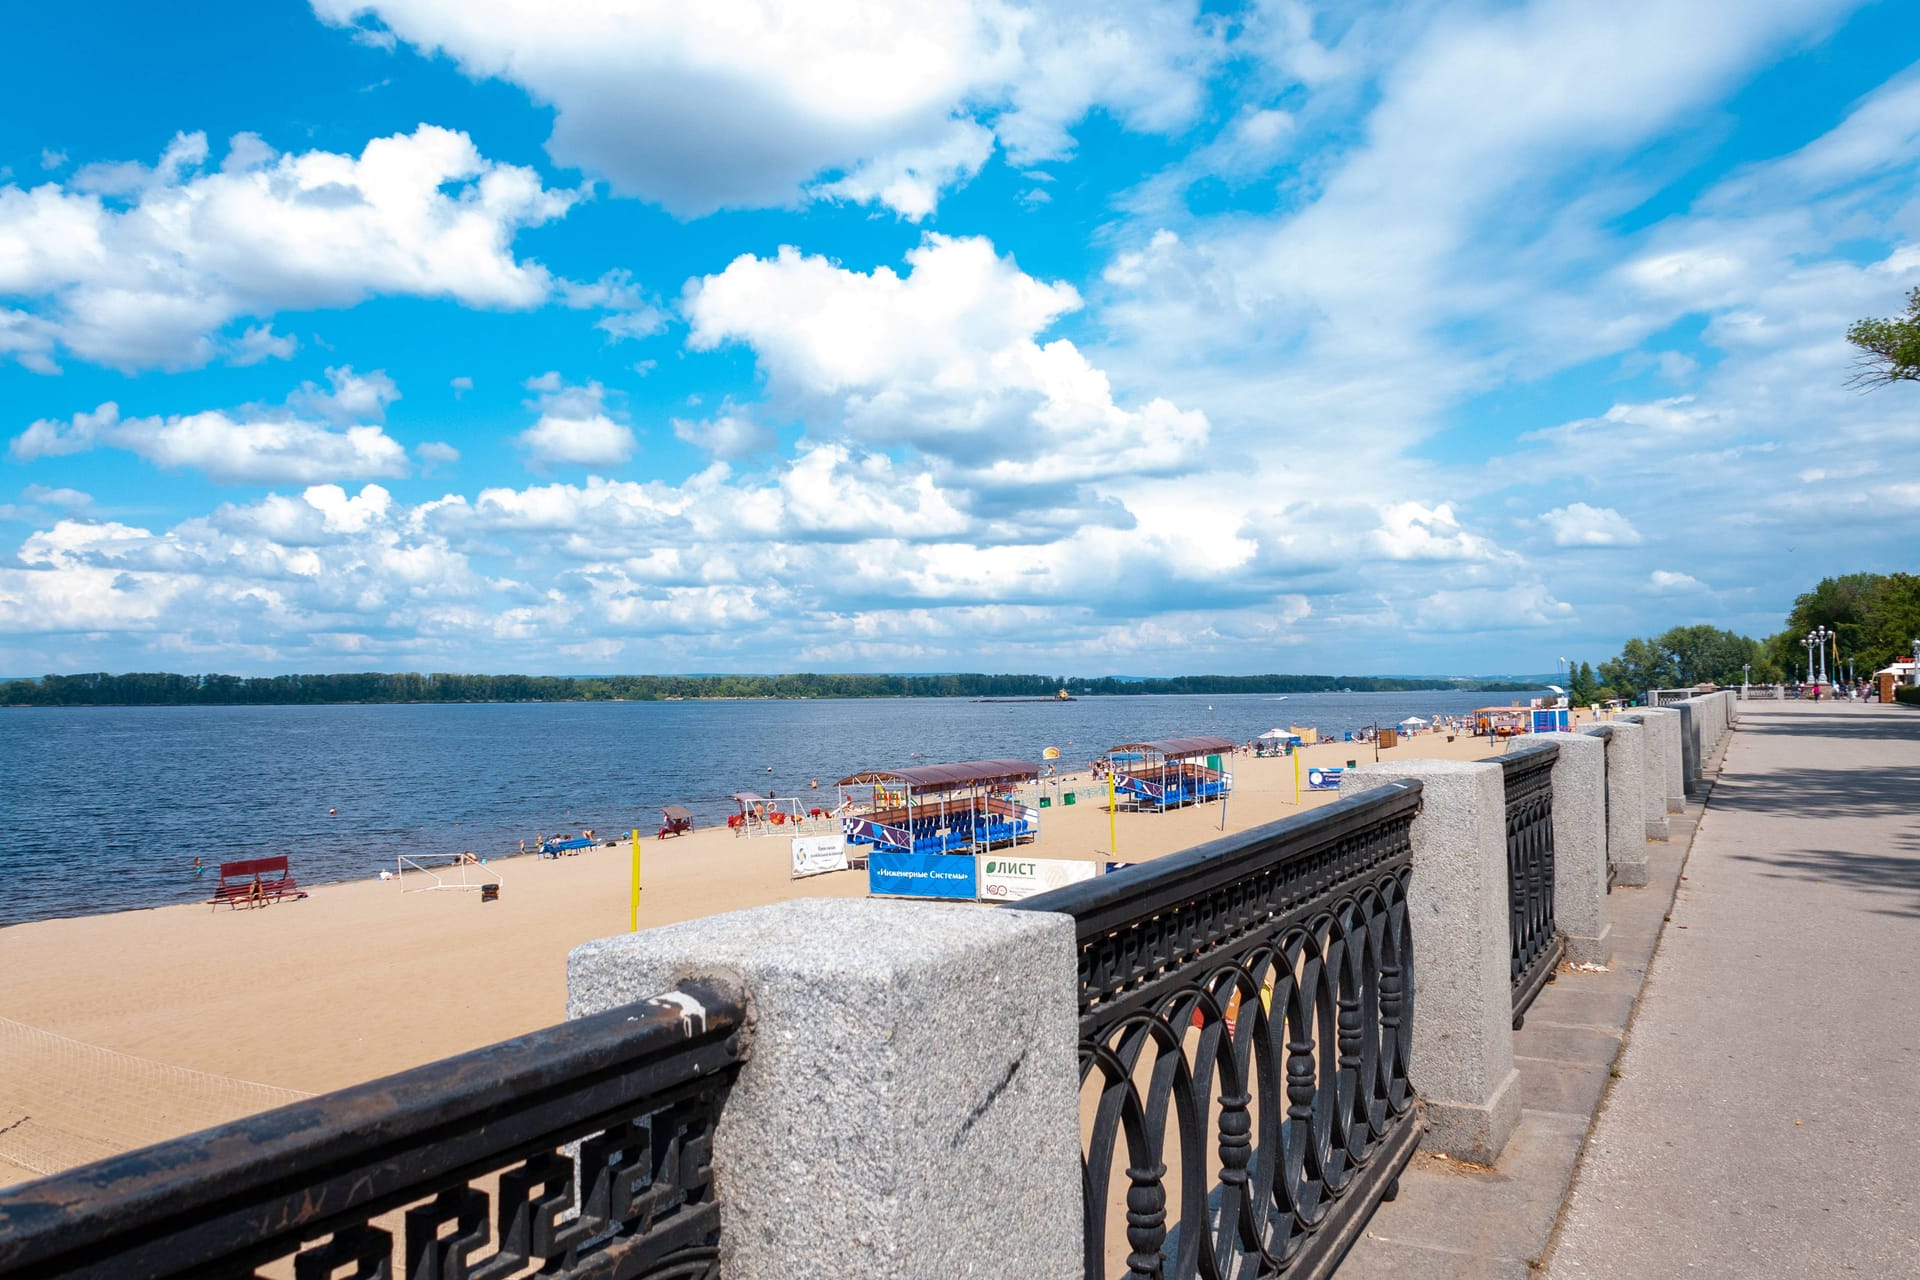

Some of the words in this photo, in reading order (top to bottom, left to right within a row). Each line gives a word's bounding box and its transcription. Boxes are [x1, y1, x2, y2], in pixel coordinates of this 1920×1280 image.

[877, 868, 928, 879] «Инженерные
[929, 870, 969, 880] Системы»
[997, 862, 1036, 875] ЛИСТ
